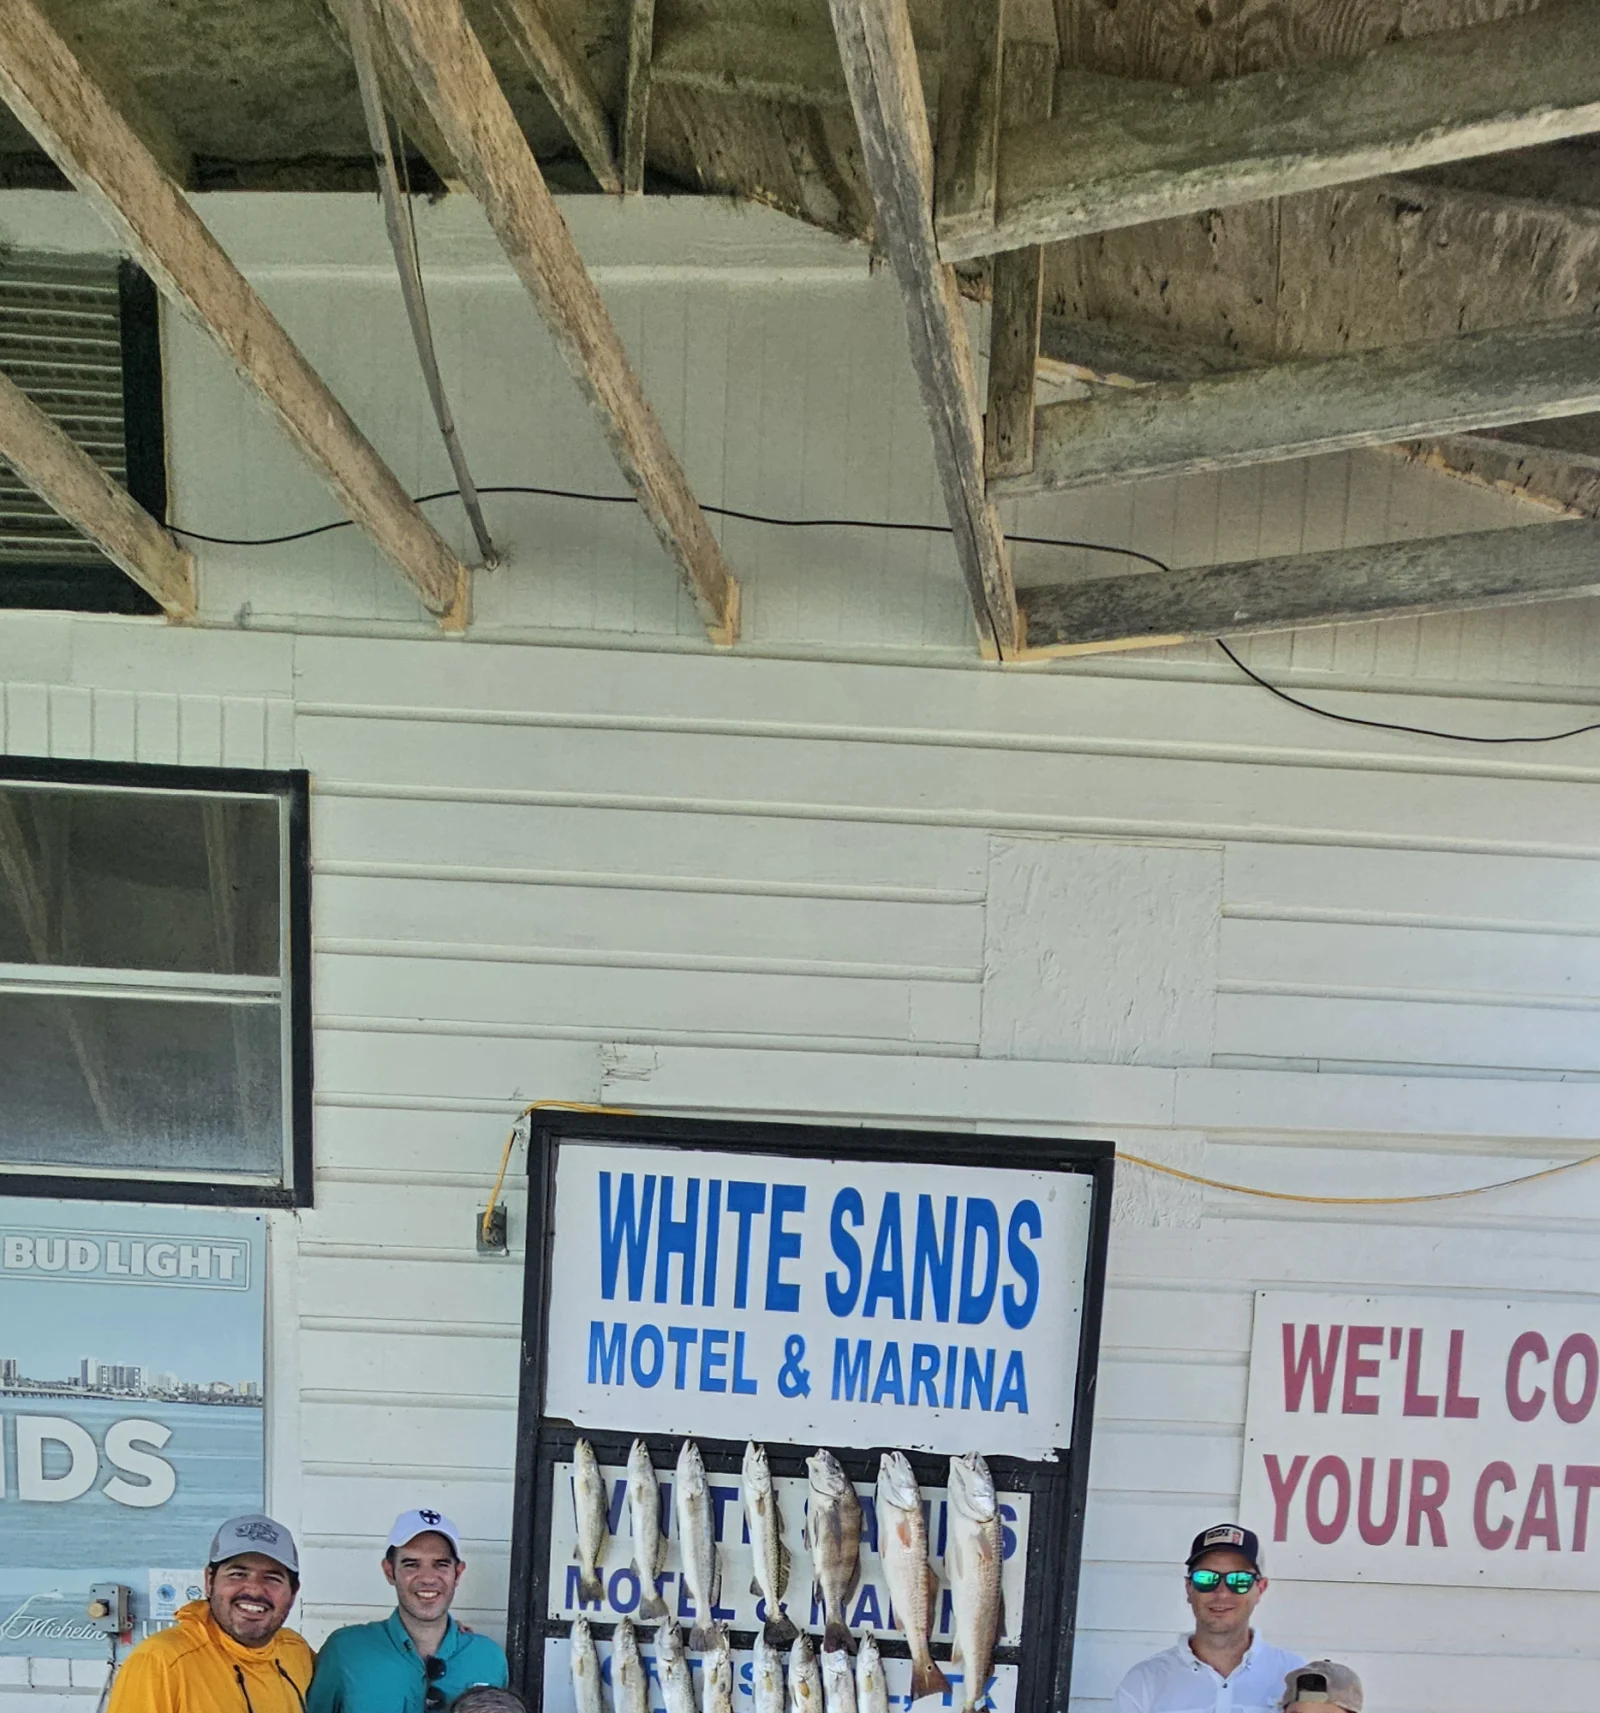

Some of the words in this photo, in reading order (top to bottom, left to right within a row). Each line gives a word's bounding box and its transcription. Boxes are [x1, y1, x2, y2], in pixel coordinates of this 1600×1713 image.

[3, 1235, 100, 1273] BUD
[105, 1241, 241, 1281] LIGHT
[599, 1170, 807, 1313] WHITE
[825, 1186, 1042, 1330] SANDS
[587, 1320, 758, 1395] MOTEL
[777, 1333, 811, 1399] &
[831, 1337, 1029, 1415] MARINA
[1281, 1322, 1480, 1420] WE'LL
[1504, 1330, 1600, 1424] CO
[0, 1413, 176, 1508] DS
[1262, 1453, 1451, 1548] YOUR
[1473, 1460, 1600, 1553] CAT
